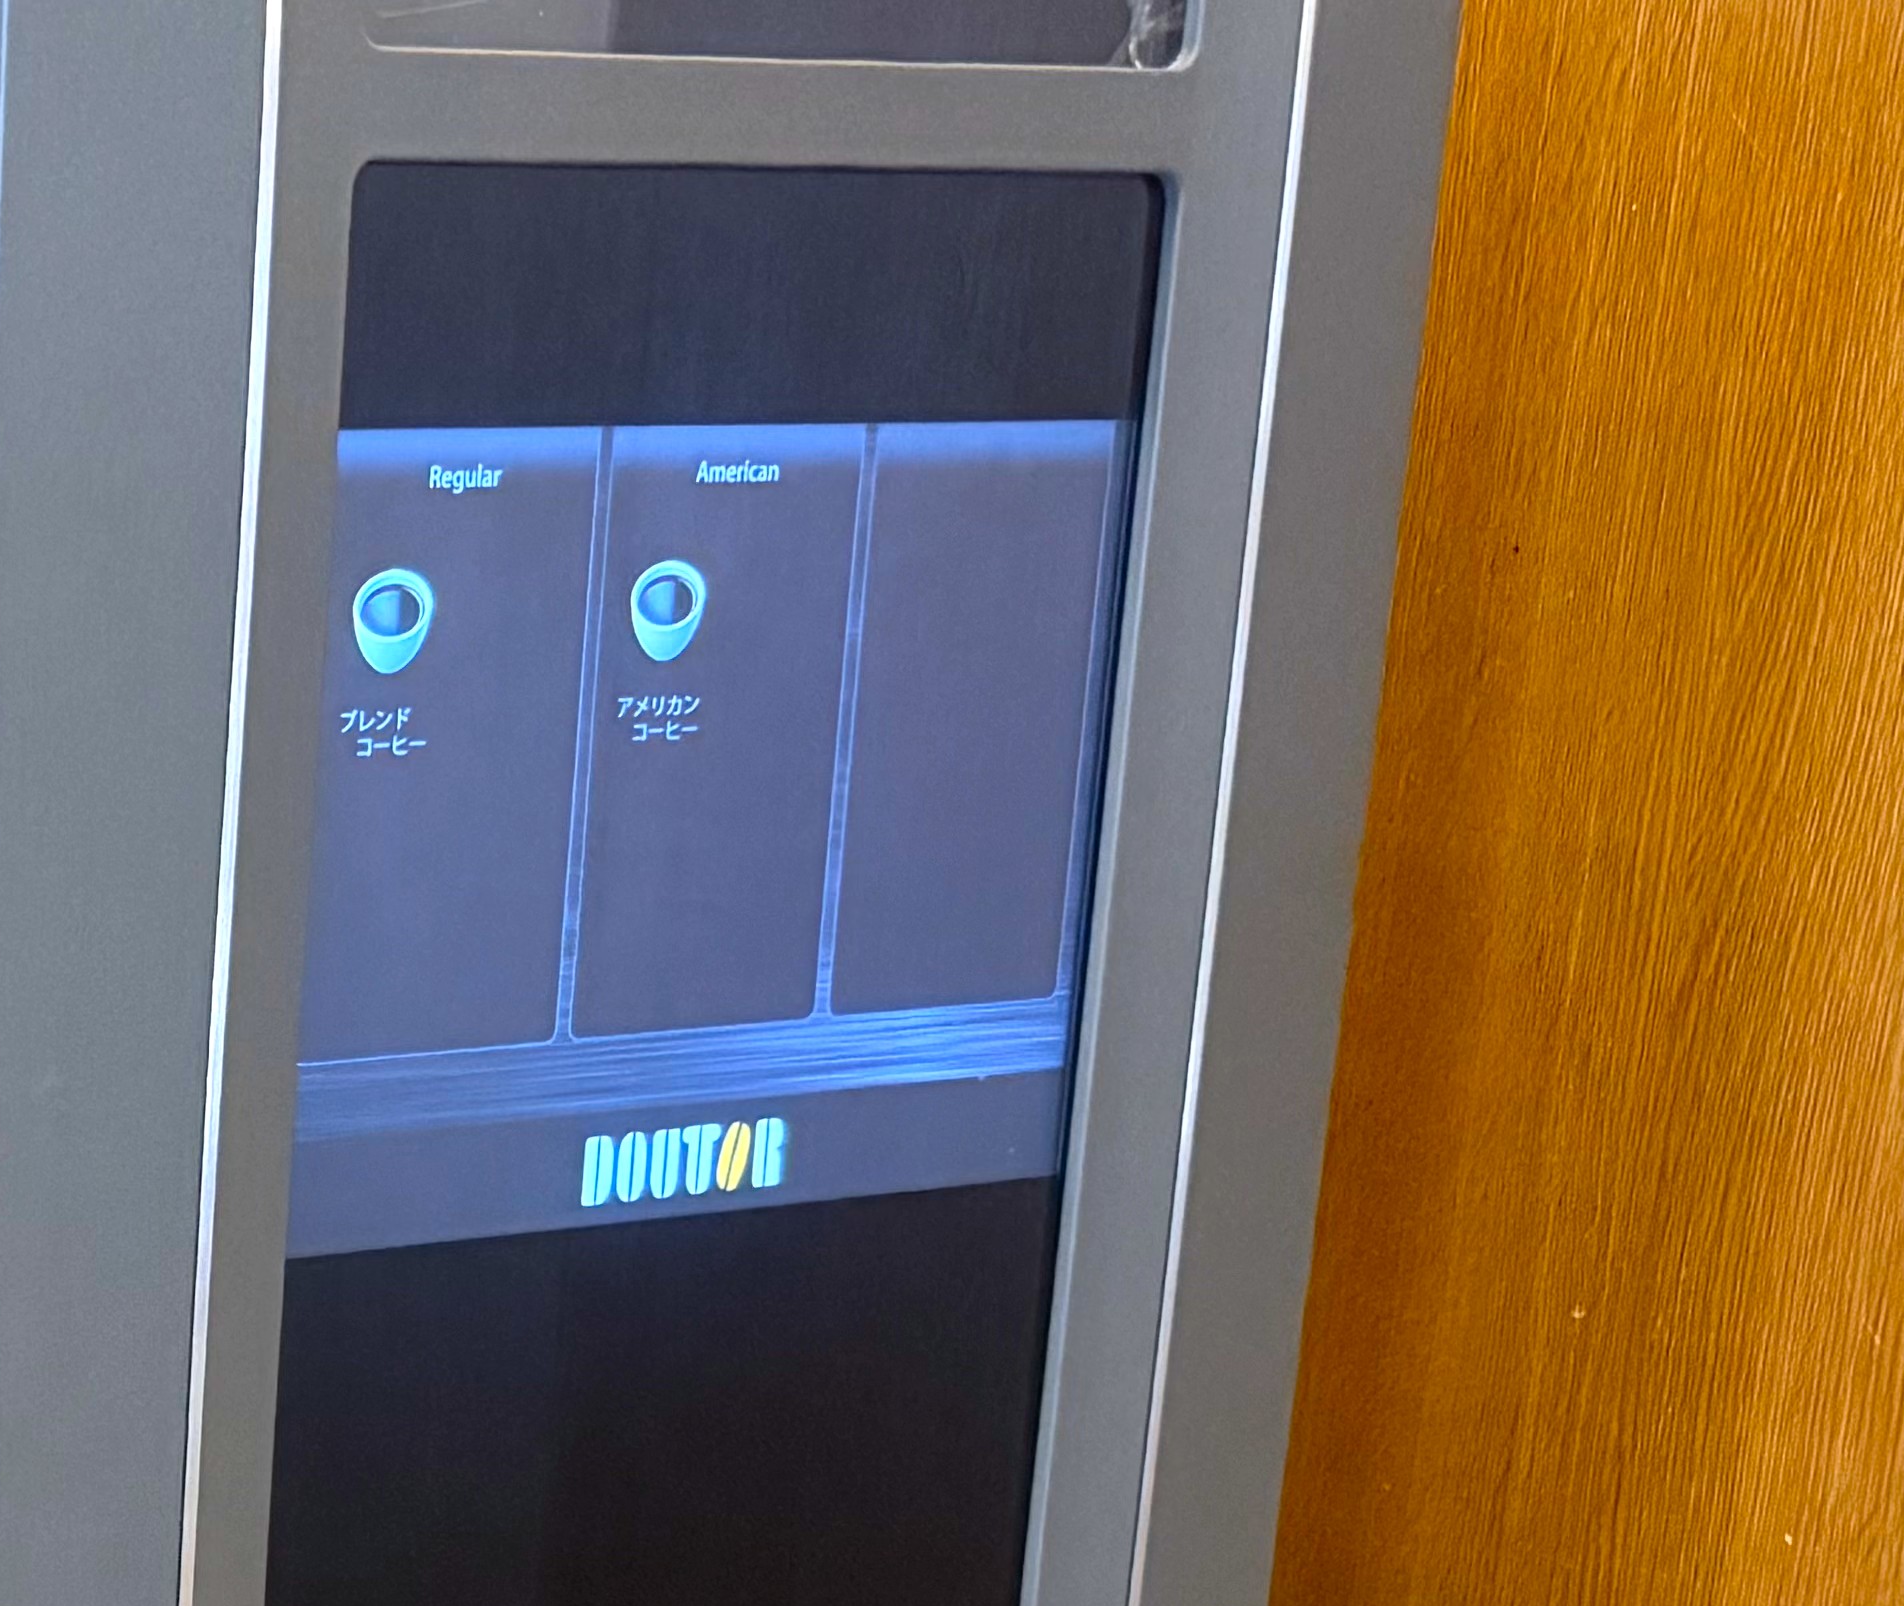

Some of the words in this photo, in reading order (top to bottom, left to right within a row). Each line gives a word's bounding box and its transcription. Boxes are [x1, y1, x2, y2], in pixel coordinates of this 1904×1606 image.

[428, 462, 503, 494] Regular
[695, 459, 780, 484] American
[616, 694, 701, 719] アメリカン
[339, 706, 412, 733] ブレンド
[631, 720, 700, 742] コーヒー
[355, 734, 428, 757] コーヒー
[580, 1117, 789, 1208] DOUTOR
